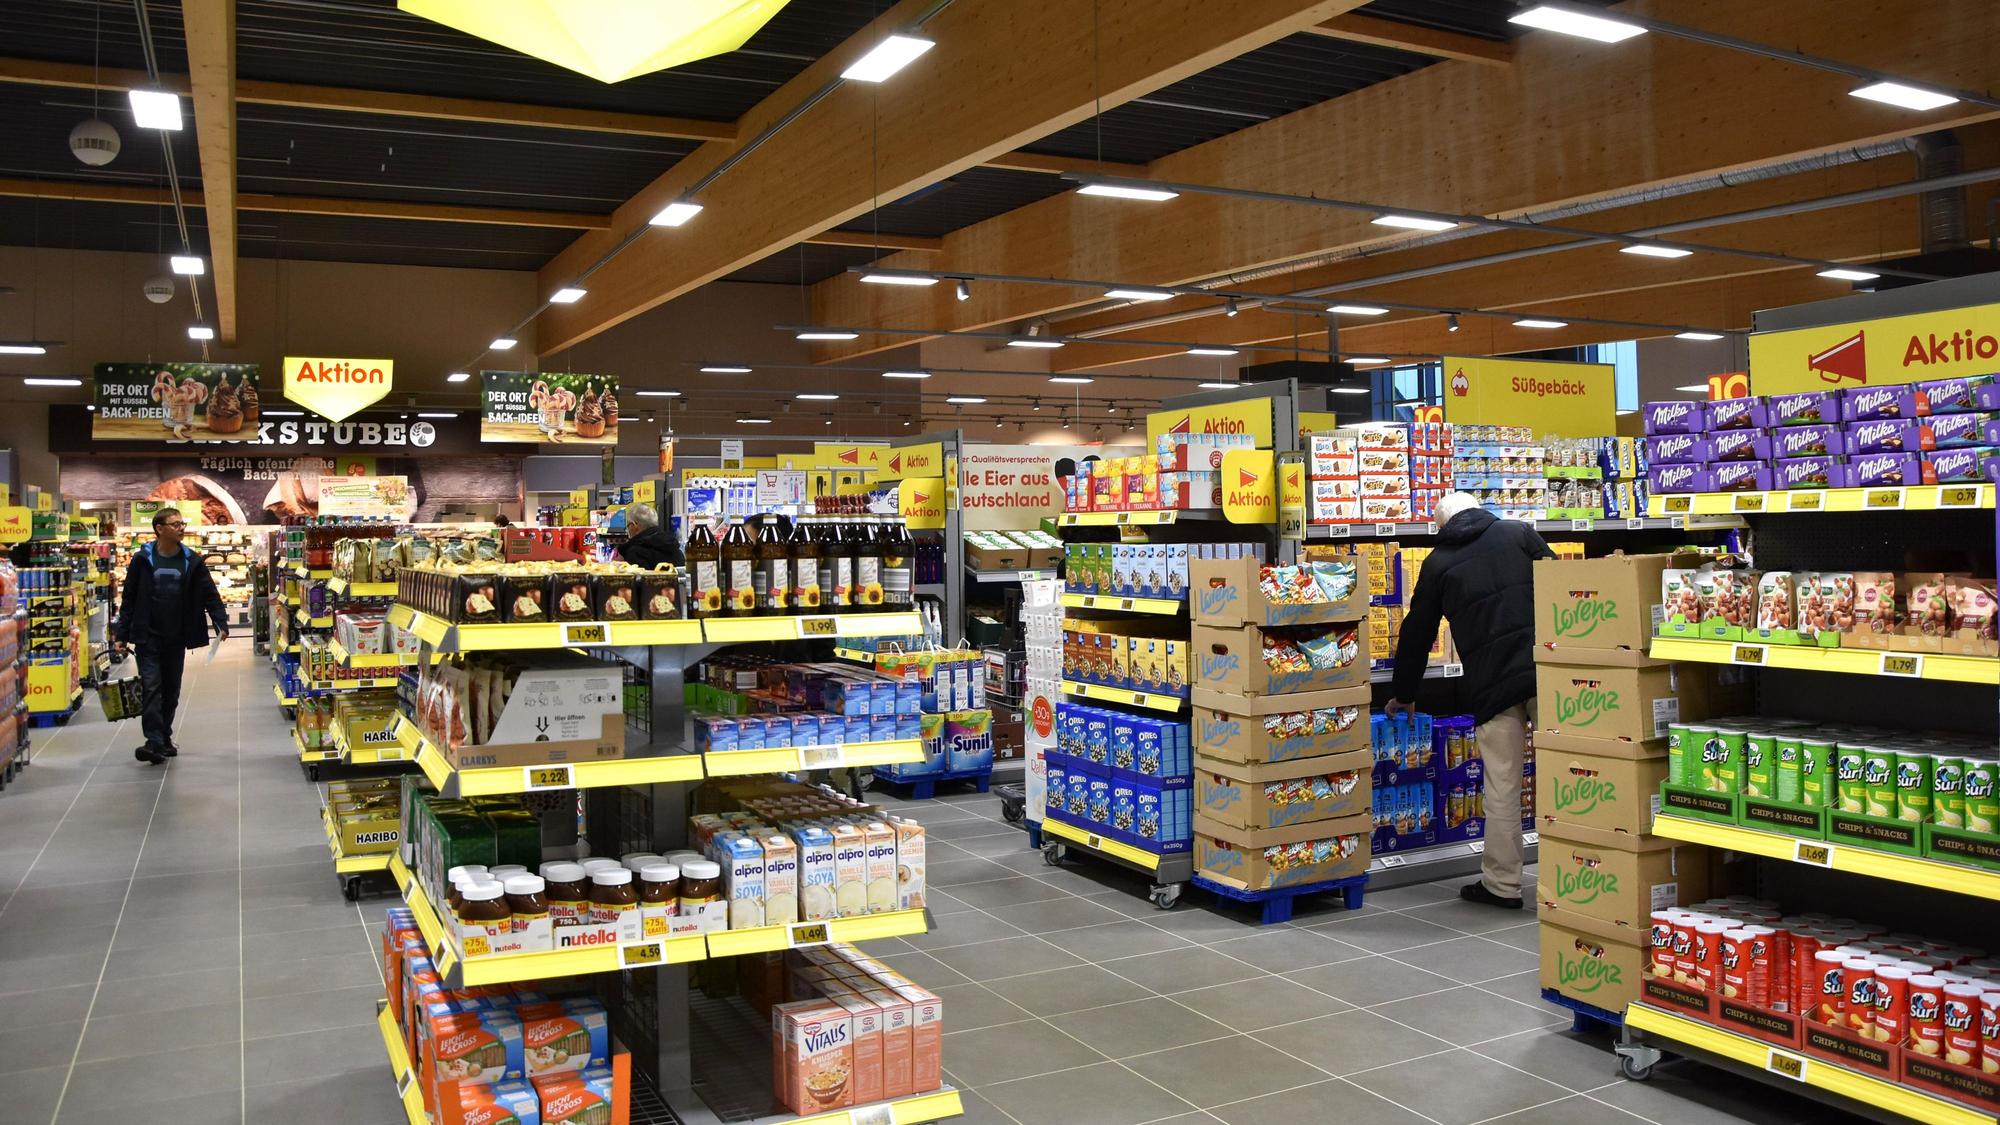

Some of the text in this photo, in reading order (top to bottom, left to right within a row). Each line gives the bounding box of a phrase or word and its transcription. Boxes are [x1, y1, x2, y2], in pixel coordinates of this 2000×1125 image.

[1903, 329, 1998, 367] Aktio
[297, 361, 383, 384] Aktion
[103, 384, 149, 396] DER ORT
[1512, 376, 1586, 396] Süßgebäck
[1927, 382, 1964, 404] Milka
[488, 392, 527, 403] DER ORT
[1855, 390, 1894, 413] Milka
[1653, 402, 1688, 425] Milka
[1714, 402, 1746, 424] Milka
[1778, 394, 1812, 418] Milka
[1204, 417, 1244, 434] Aktion
[1856, 422, 1896, 444] Milka
[1932, 415, 1970, 436] Milka
[1657, 436, 1692, 458] Milka
[1716, 432, 1748, 454] Milka
[1784, 428, 1820, 452] Milka
[201, 457, 251, 475] Täglich
[907, 454, 929, 468] Aktion
[972, 454, 1050, 464] Qualitätsversprechen
[1934, 452, 1970, 474] Milka
[1659, 465, 1694, 488] Milka
[1717, 463, 1750, 484] Milka
[1785, 459, 1820, 482] Milka
[1858, 457, 1896, 480] Milka
[985, 470, 1015, 486] Eier
[1020, 474, 1050, 486] aus
[963, 492, 1050, 508] eutschland
[1228, 491, 1270, 506] Aktion
[1284, 494, 1302, 504] Aktion
[1882, 494, 1900, 503] 0.79
[1956, 491, 1976, 502] 0.79
[904, 506, 940, 517] Aktion
[1286, 520, 1300, 532] 2.19
[1552, 599, 1618, 637] Lorenz
[575, 628, 598, 638] 1.99
[810, 622, 830, 632] 1.99
[1742, 650, 1758, 659] 1.79
[1892, 660, 1910, 670] 1.79
[1555, 688, 1620, 724] Lorenz
[1114, 727, 1132, 736] OREO
[1139, 732, 1158, 741] OREO
[953, 732, 990, 752] Sunil
[460, 754, 496, 766] CLARKYS
[541, 772, 562, 783] 2.22
[1839, 766, 1864, 780] Surf
[1866, 769, 1890, 783] Surf
[1898, 773, 1923, 787] Surf
[1934, 776, 1964, 792] Surf
[1966, 782, 1994, 796] Surf
[1114, 788, 1132, 797] OREO
[1139, 795, 1158, 804] OREO
[1554, 776, 1616, 810] Lorenz
[1670, 794, 1692, 805] CHIPS
[1700, 800, 1726, 810] SNACKS
[1752, 808, 1774, 818] CHIPS
[1782, 812, 1814, 825] SNACKS
[356, 831, 398, 844] HARIBO
[1838, 822, 1864, 834] CHIPS
[1874, 827, 1908, 840] SNACKS
[838, 849, 864, 862] alpro
[868, 846, 894, 859] alpro
[1806, 848, 1823, 859] 1.69
[1938, 839, 1966, 851] CHIPS
[1976, 844, 2000, 858] SNAC
[806, 851, 832, 864] alpro
[735, 864, 762, 878] alpro
[768, 860, 795, 874] alpro
[808, 871, 834, 885] SOYA
[1556, 864, 1619, 898] Lorenz
[736, 886, 762, 898] SOYA
[673, 924, 698, 932] nutella
[801, 929, 821, 940] 1.49
[561, 930, 616, 946] nutella
[1652, 935, 1672, 948] Surf
[494, 944, 521, 952] nutella
[640, 947, 660, 958] 4.59
[1558, 951, 1622, 985] Lorenz
[1650, 985, 1671, 996] CHIPS
[1910, 1004, 1940, 1019] Surf
[1726, 1008, 1748, 1020] CHIPS
[1756, 1016, 1788, 1032] SNACKS
[1945, 1013, 1972, 1030] Surf
[528, 1020, 552, 1039] LEICHT
[440, 1032, 466, 1051] LEICHT
[805, 1024, 846, 1052] VITALIS
[1812, 1034, 1882, 1062] CHIPS & SNACKS
[1778, 1058, 1796, 1071] 1.69
[1912, 1064, 1942, 1080] CHIPS
[546, 1093, 572, 1112] LEICHT
